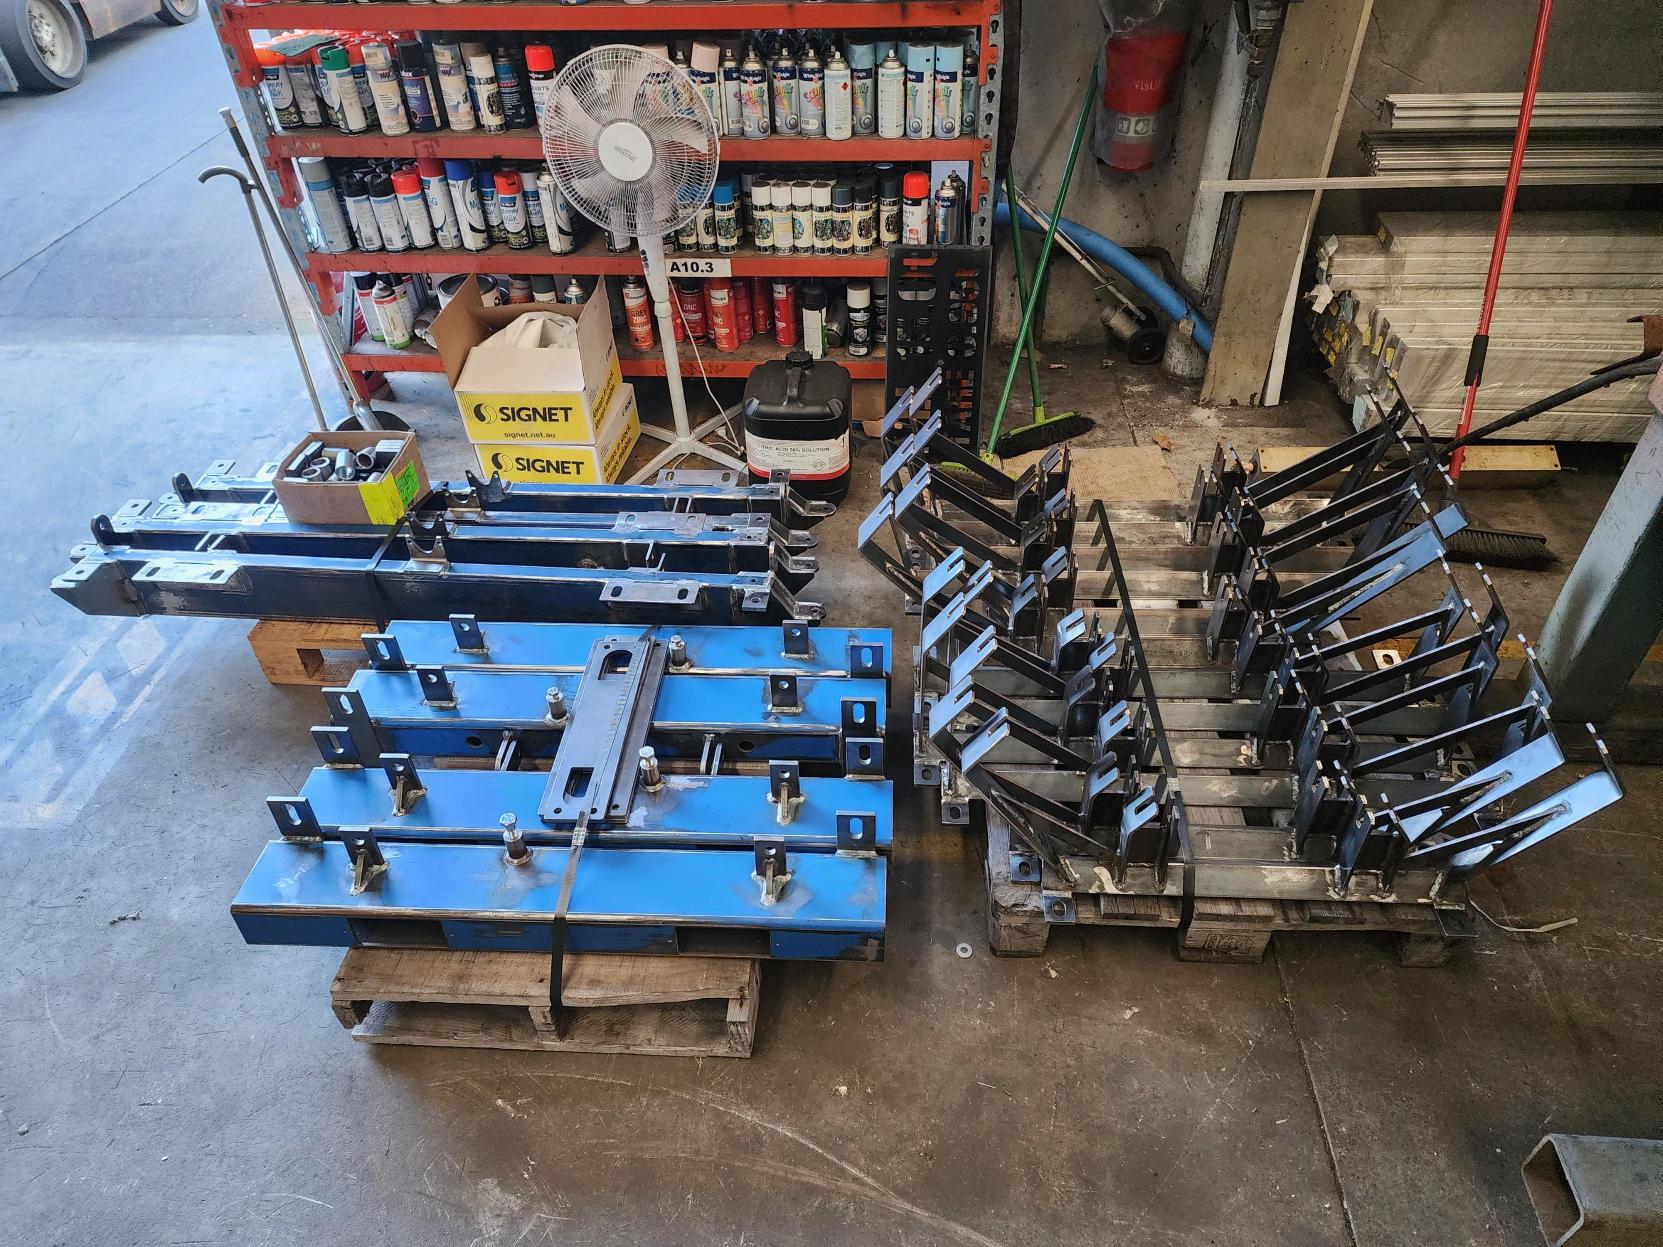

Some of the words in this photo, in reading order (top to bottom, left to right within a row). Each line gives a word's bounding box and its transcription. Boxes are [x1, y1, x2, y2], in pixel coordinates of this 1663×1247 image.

[670, 261, 714, 273] A10.3
[498, 406, 572, 422] SIGNET
[503, 431, 556, 439] signet.net.au
[514, 457, 585, 475] SIGNET
